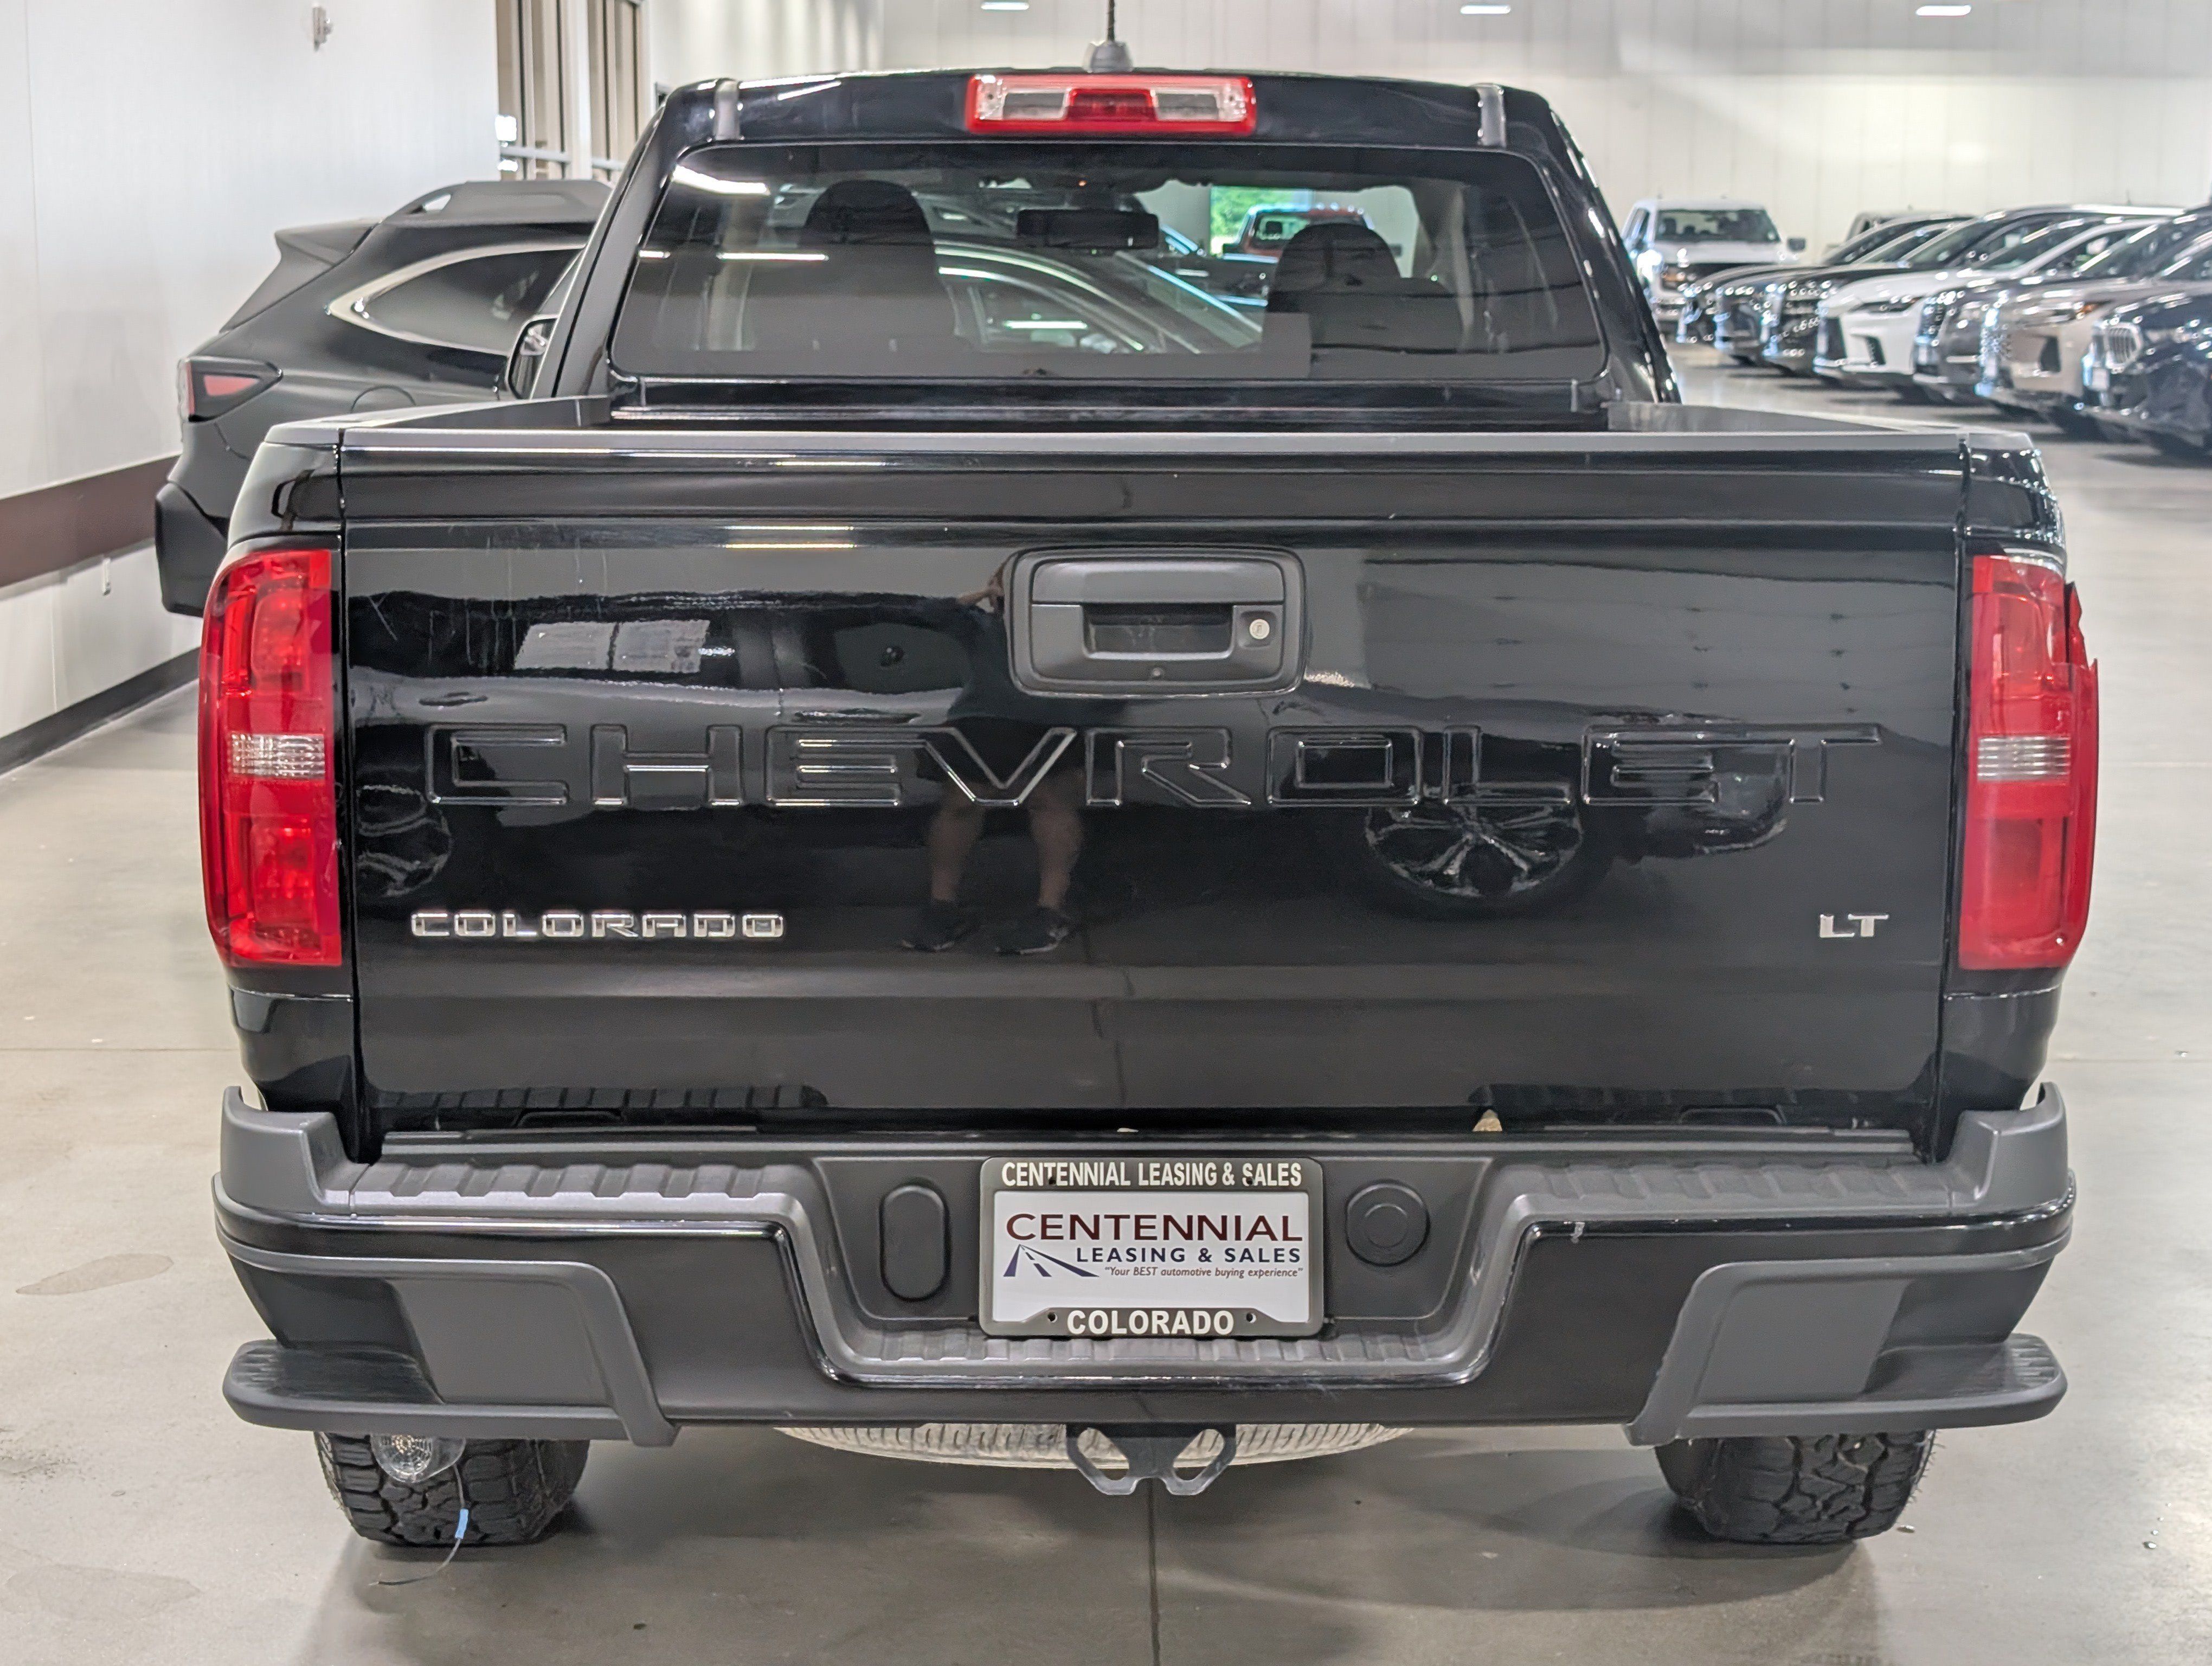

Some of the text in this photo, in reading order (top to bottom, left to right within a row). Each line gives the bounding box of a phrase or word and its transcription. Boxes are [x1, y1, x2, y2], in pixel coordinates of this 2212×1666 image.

[425, 722, 1881, 808] CHEVROLET
[410, 912, 785, 938] COLORADO
[1819, 914, 1889, 938] LT
[1002, 1162, 1302, 1187] CENTENNIAL LEASING & SALES
[1006, 1213, 1303, 1241] CENTENNIAL
[1077, 1247, 1300, 1263] LEASING & SALES
[1133, 1266, 1158, 1276] BEST
[1161, 1267, 1212, 1277] automotive
[1215, 1267, 1245, 1279] buying
[1067, 1310, 1234, 1335] COLORADO
